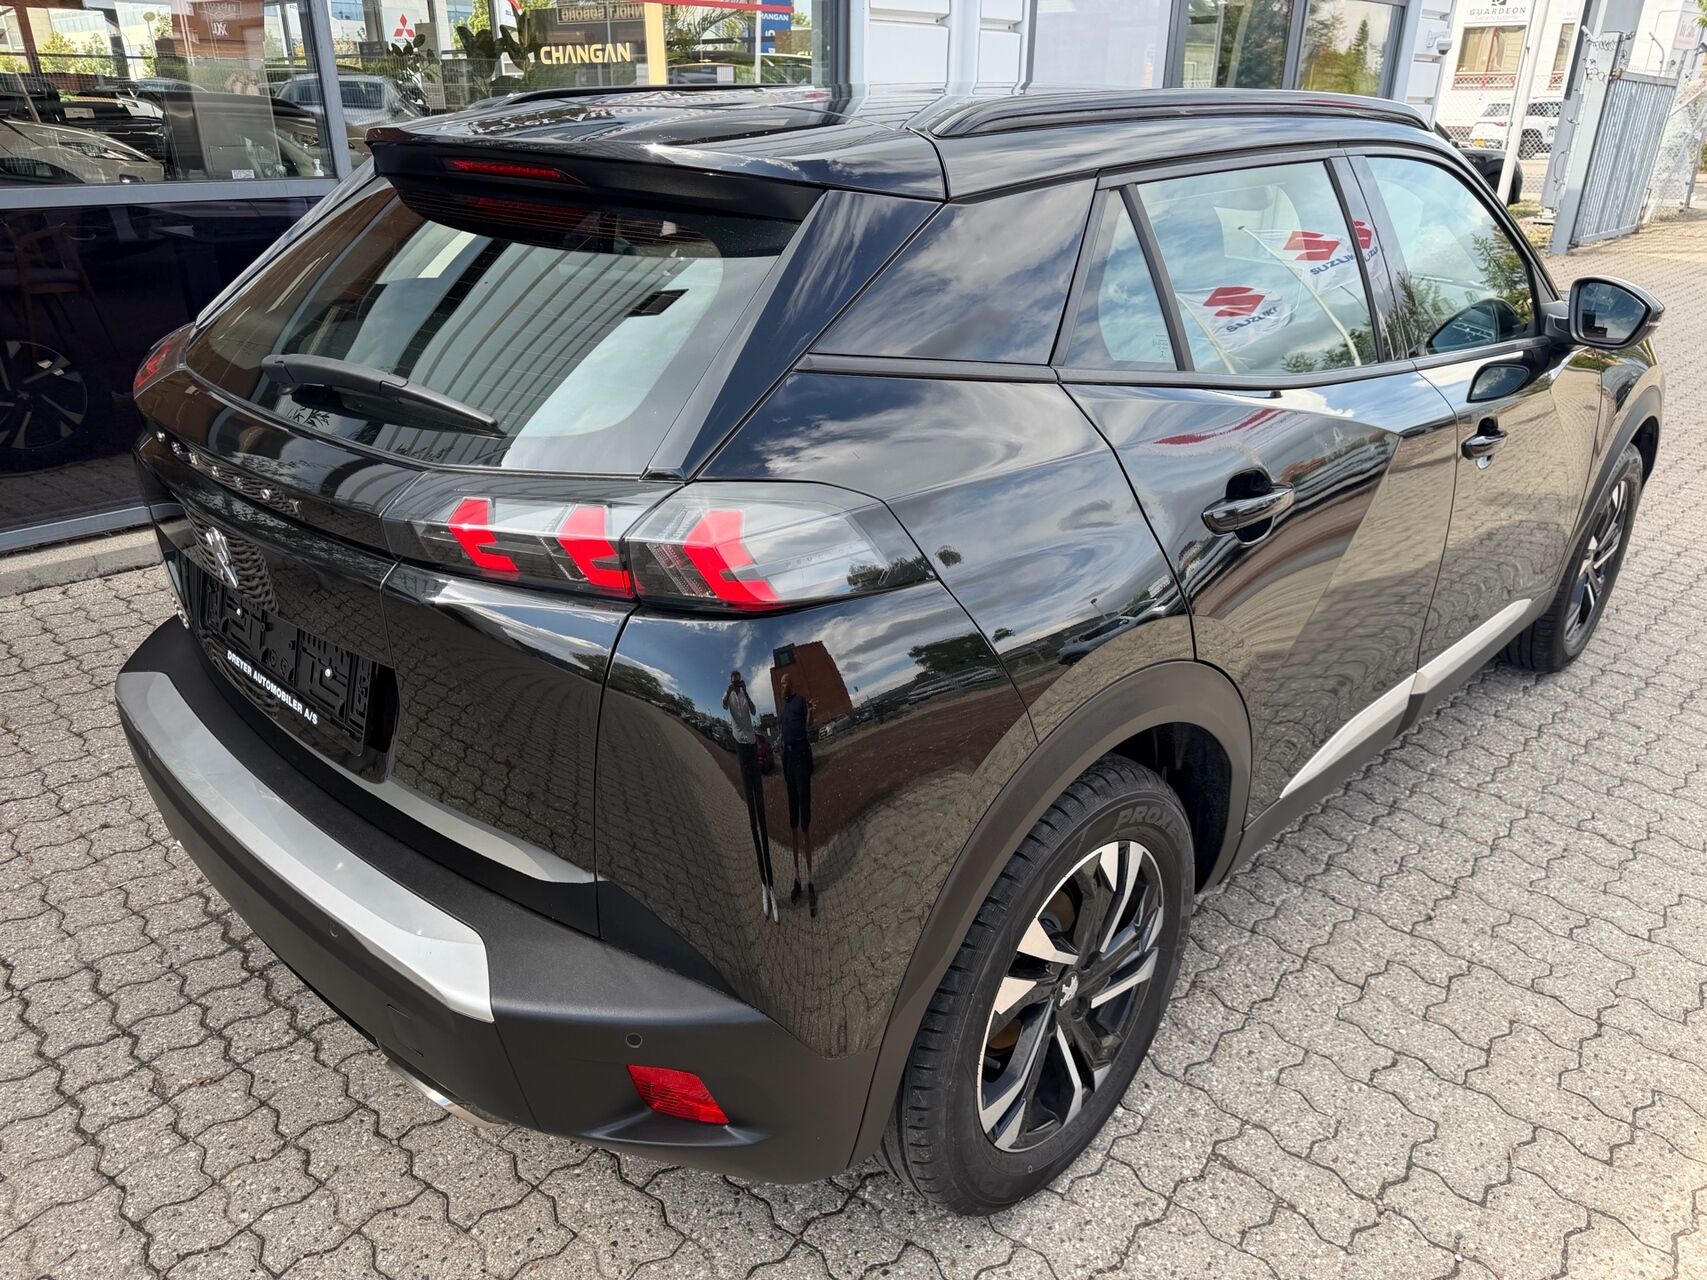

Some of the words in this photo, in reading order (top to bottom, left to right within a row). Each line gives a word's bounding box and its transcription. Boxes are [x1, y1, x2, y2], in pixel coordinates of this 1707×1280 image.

[1469, 7, 1527, 16] GUARDEON
[539, 42, 631, 65] CHANGAN
[1226, 306, 1279, 331] SUZUKI
[227, 649, 252, 677] DREYER
[252, 670, 303, 715] AUTOMOBILER
[303, 707, 318, 726] A/S
